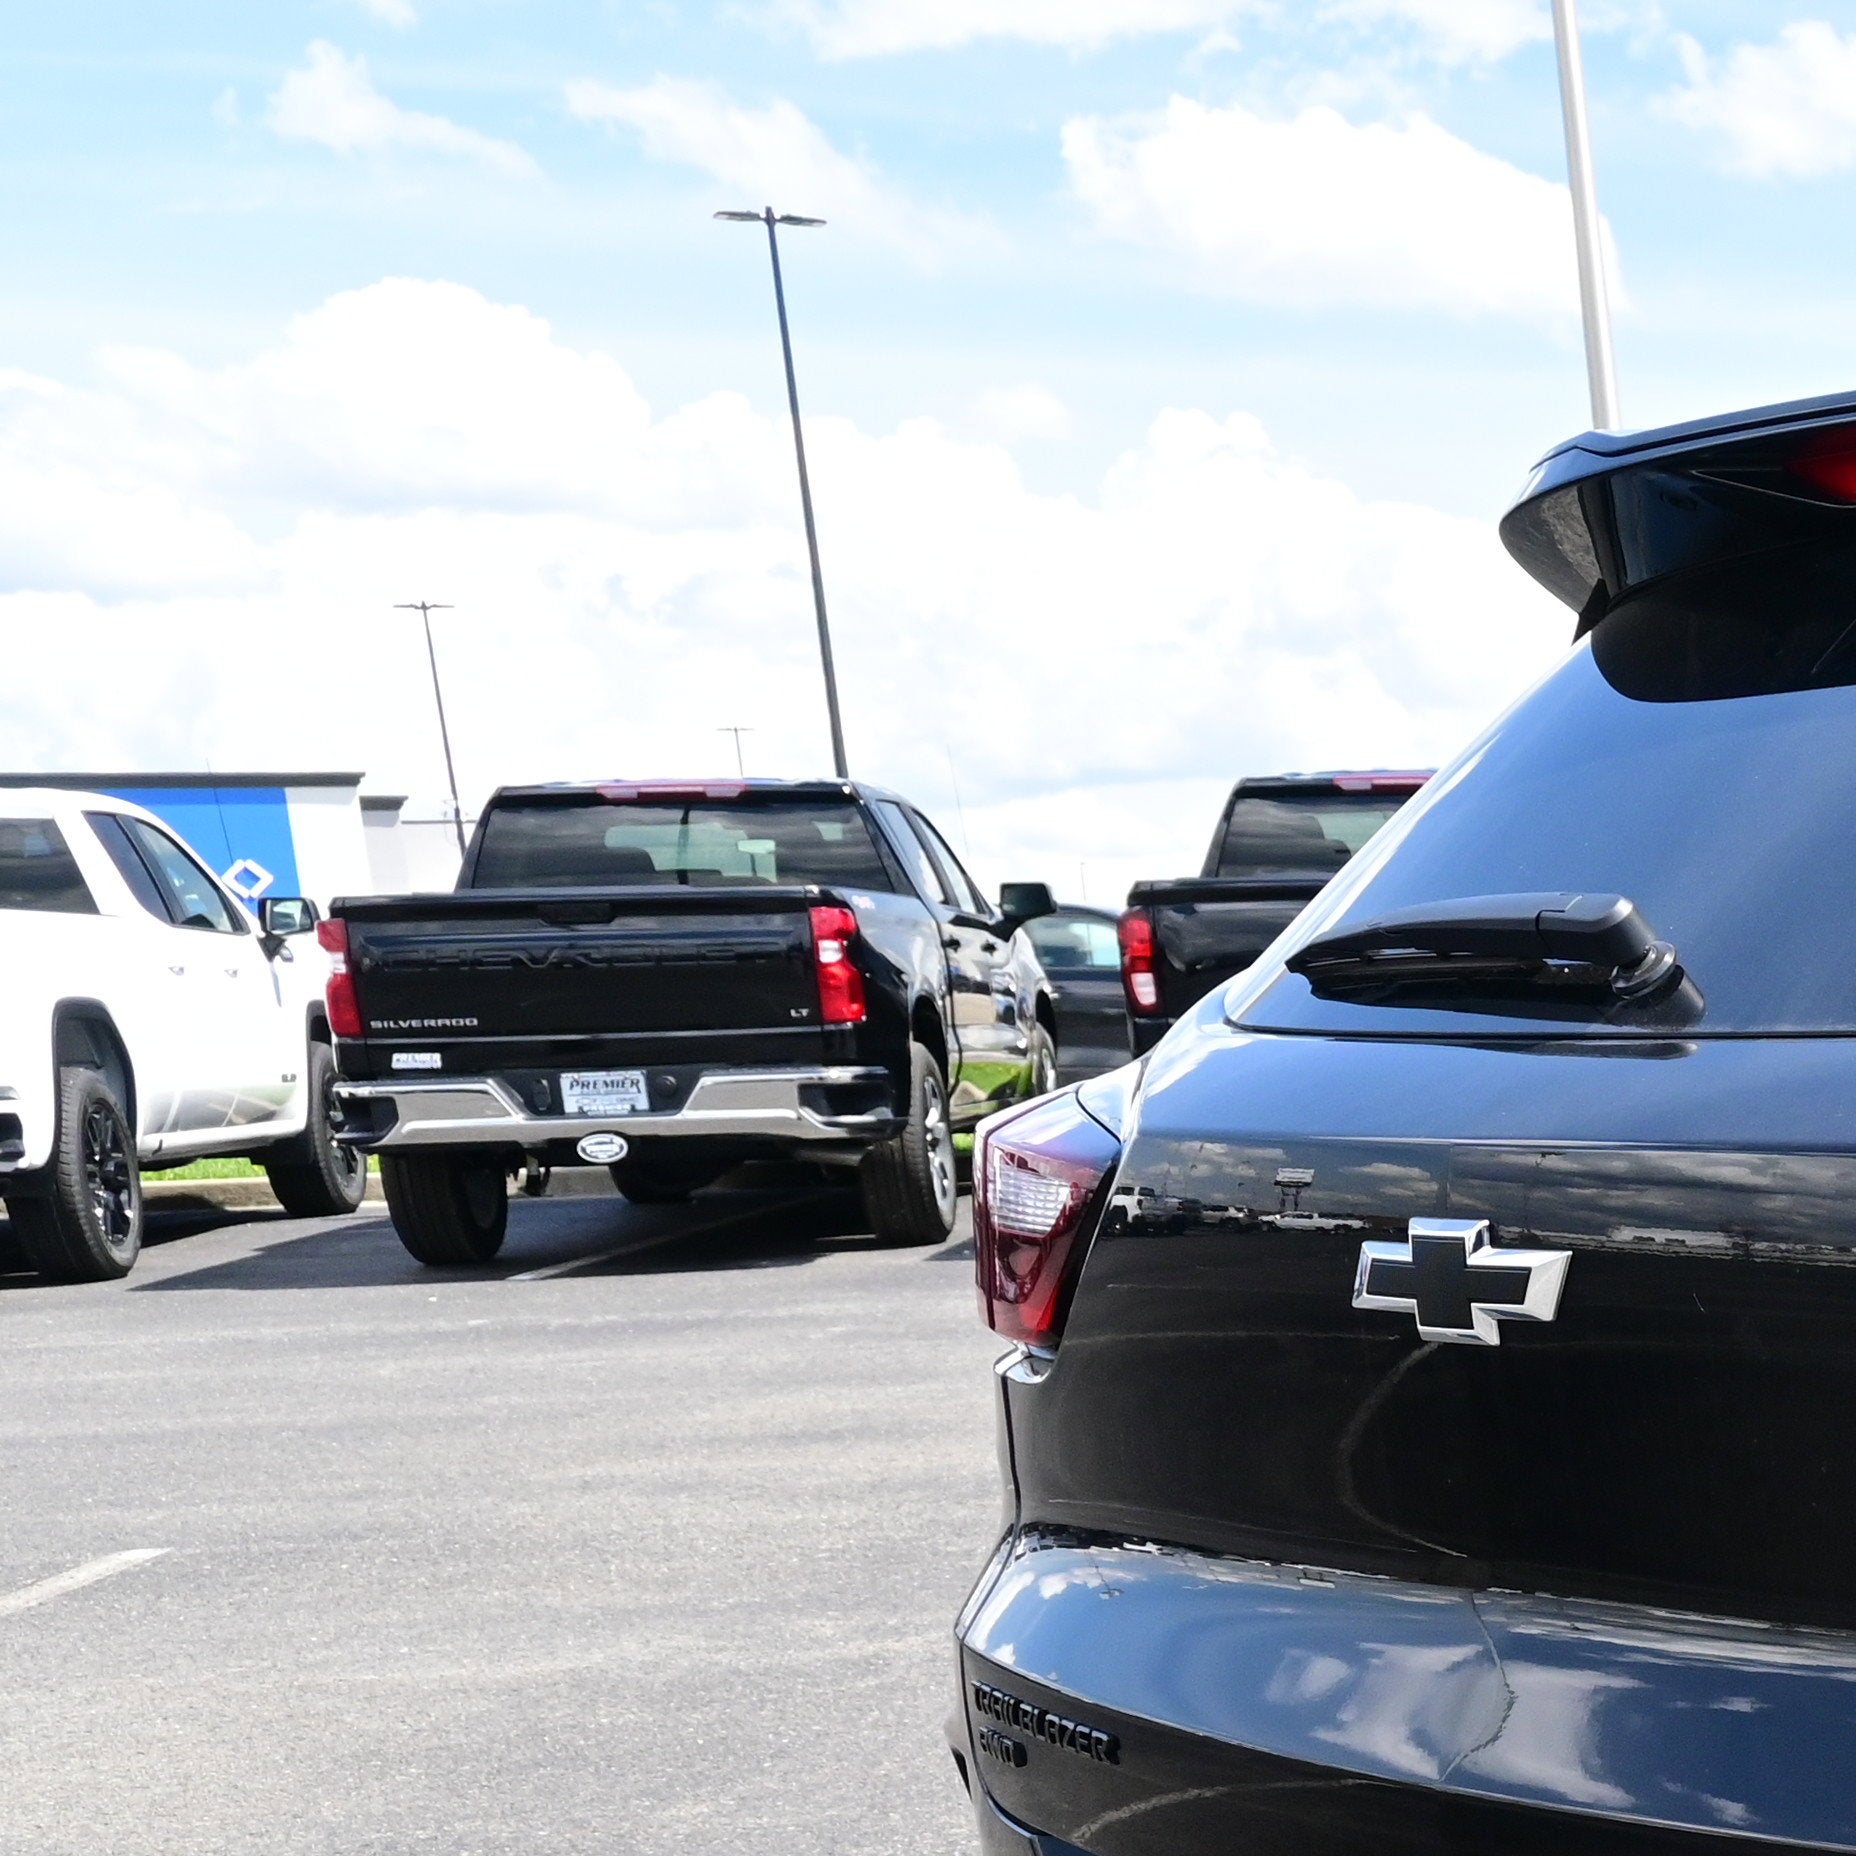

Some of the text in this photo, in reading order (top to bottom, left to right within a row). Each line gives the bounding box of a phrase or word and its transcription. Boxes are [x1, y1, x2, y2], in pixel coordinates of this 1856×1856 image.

[789, 1008, 810, 1018] LT
[369, 1017, 479, 1030] SILVERADO
[568, 1078, 642, 1094] PREMIER
[970, 1680, 1121, 1765] TRAILBLAZER
